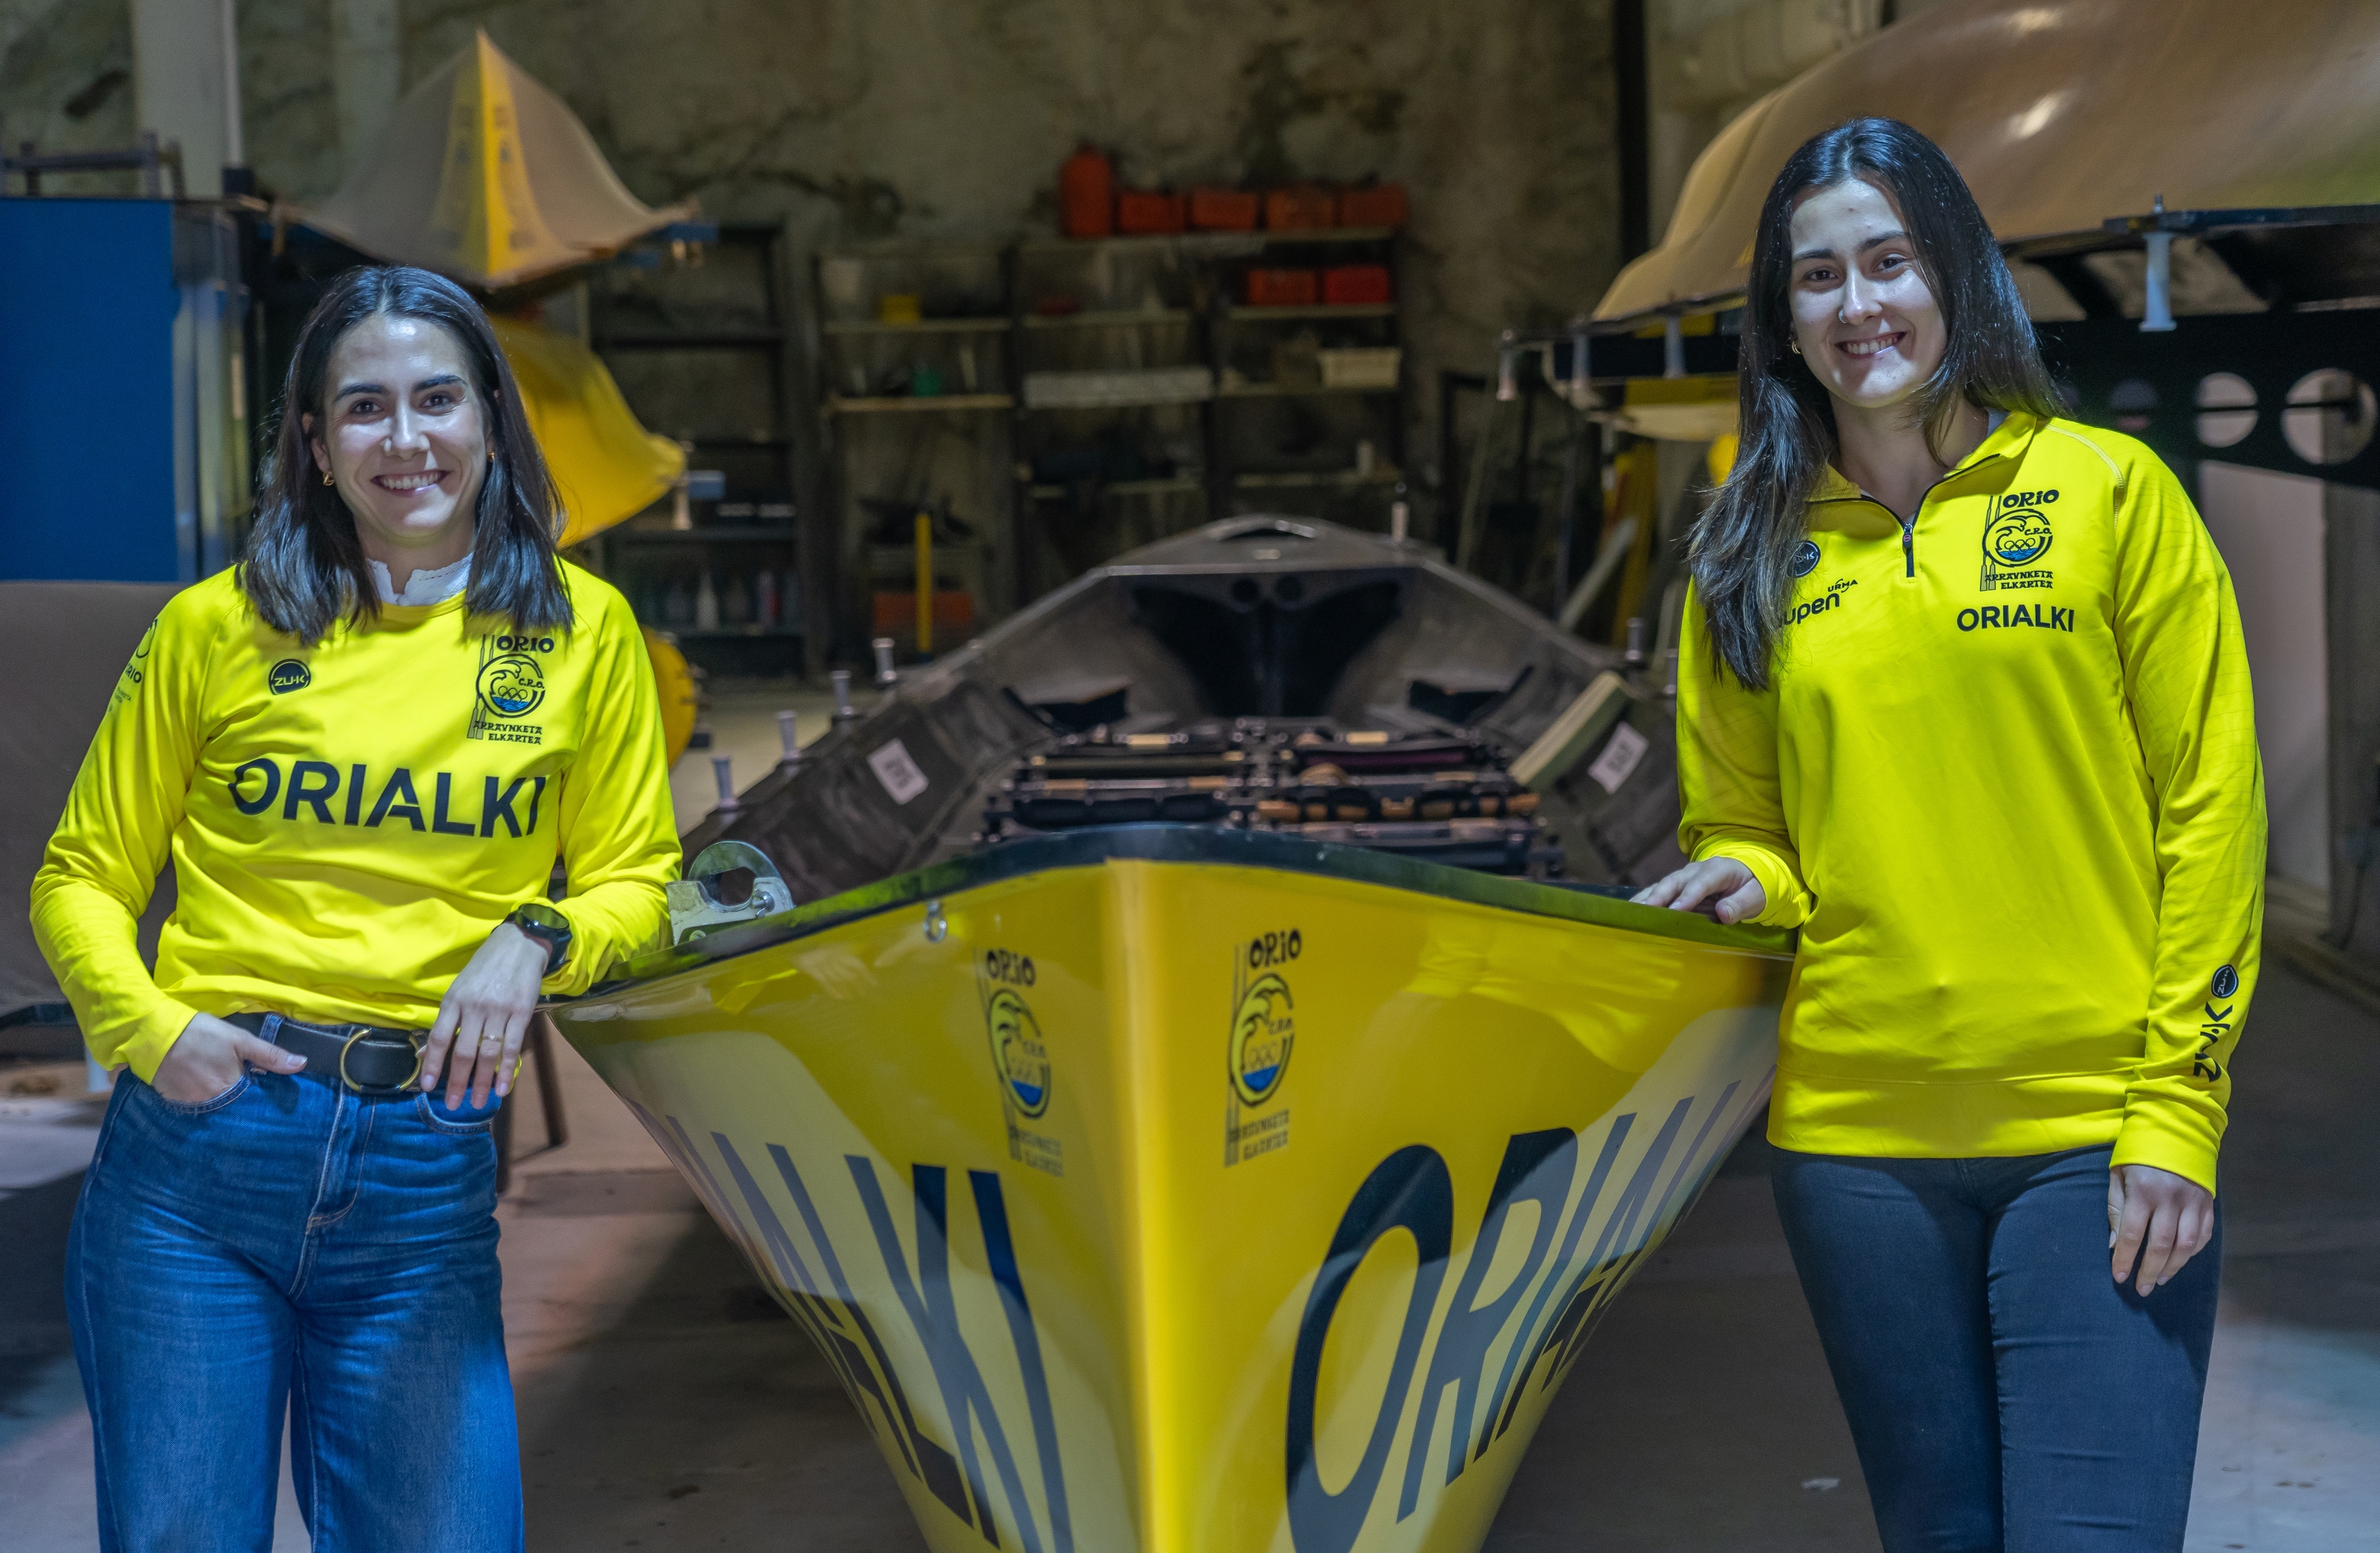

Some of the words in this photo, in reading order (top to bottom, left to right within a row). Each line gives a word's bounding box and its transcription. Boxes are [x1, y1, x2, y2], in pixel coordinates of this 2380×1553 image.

[1827, 579, 1859, 592] URMA
[2000, 580, 2053, 590] ELKARTEA
[1776, 592, 1840, 628] upen
[1956, 604, 2075, 633] ORIALKI
[125, 662, 142, 684] RIO
[487, 733, 542, 746] ELKARTEA
[228, 757, 547, 838] ORIALKI
[1285, 1063, 1777, 1553] ORIAL
